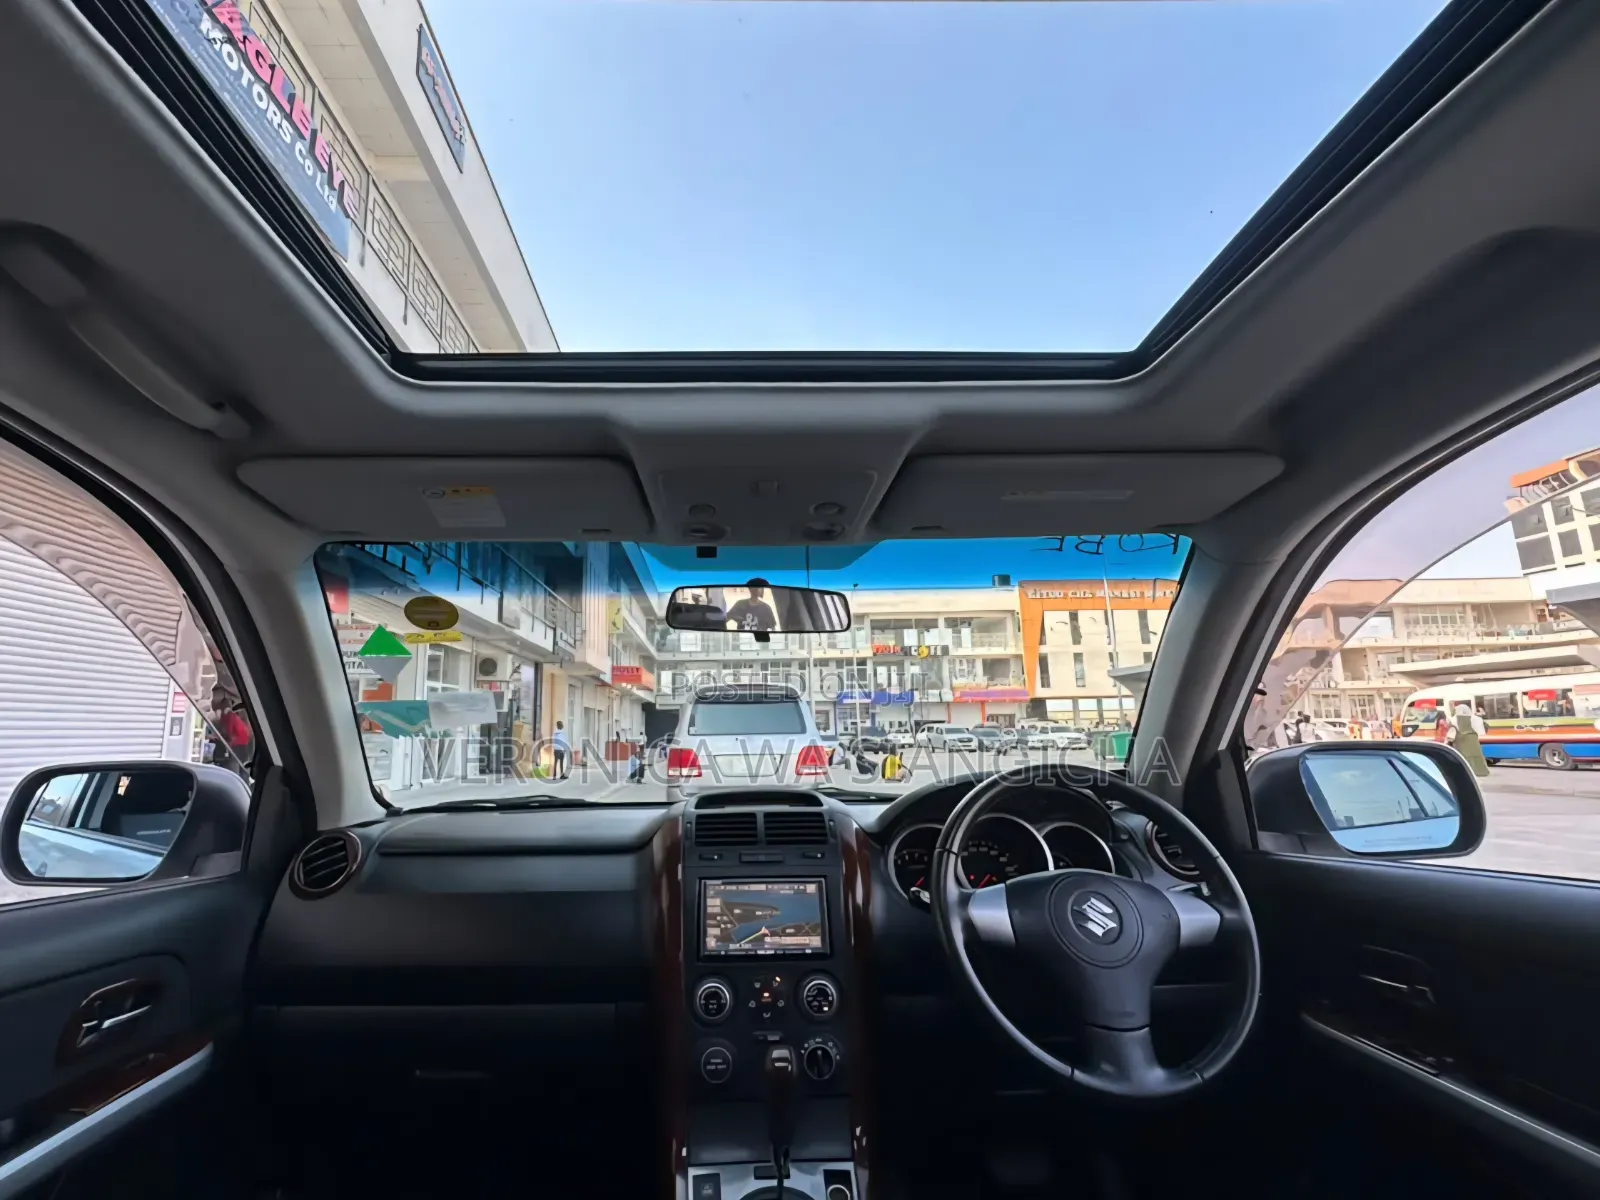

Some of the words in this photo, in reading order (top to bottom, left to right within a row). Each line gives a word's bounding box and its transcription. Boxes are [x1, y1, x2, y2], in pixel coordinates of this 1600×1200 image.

[200, 11, 293, 144] MOTORS
[294, 141, 314, 176] Co
[315, 172, 337, 213] Ltd
[206, 0, 312, 140] AGLE
[313, 133, 361, 218] EYE
